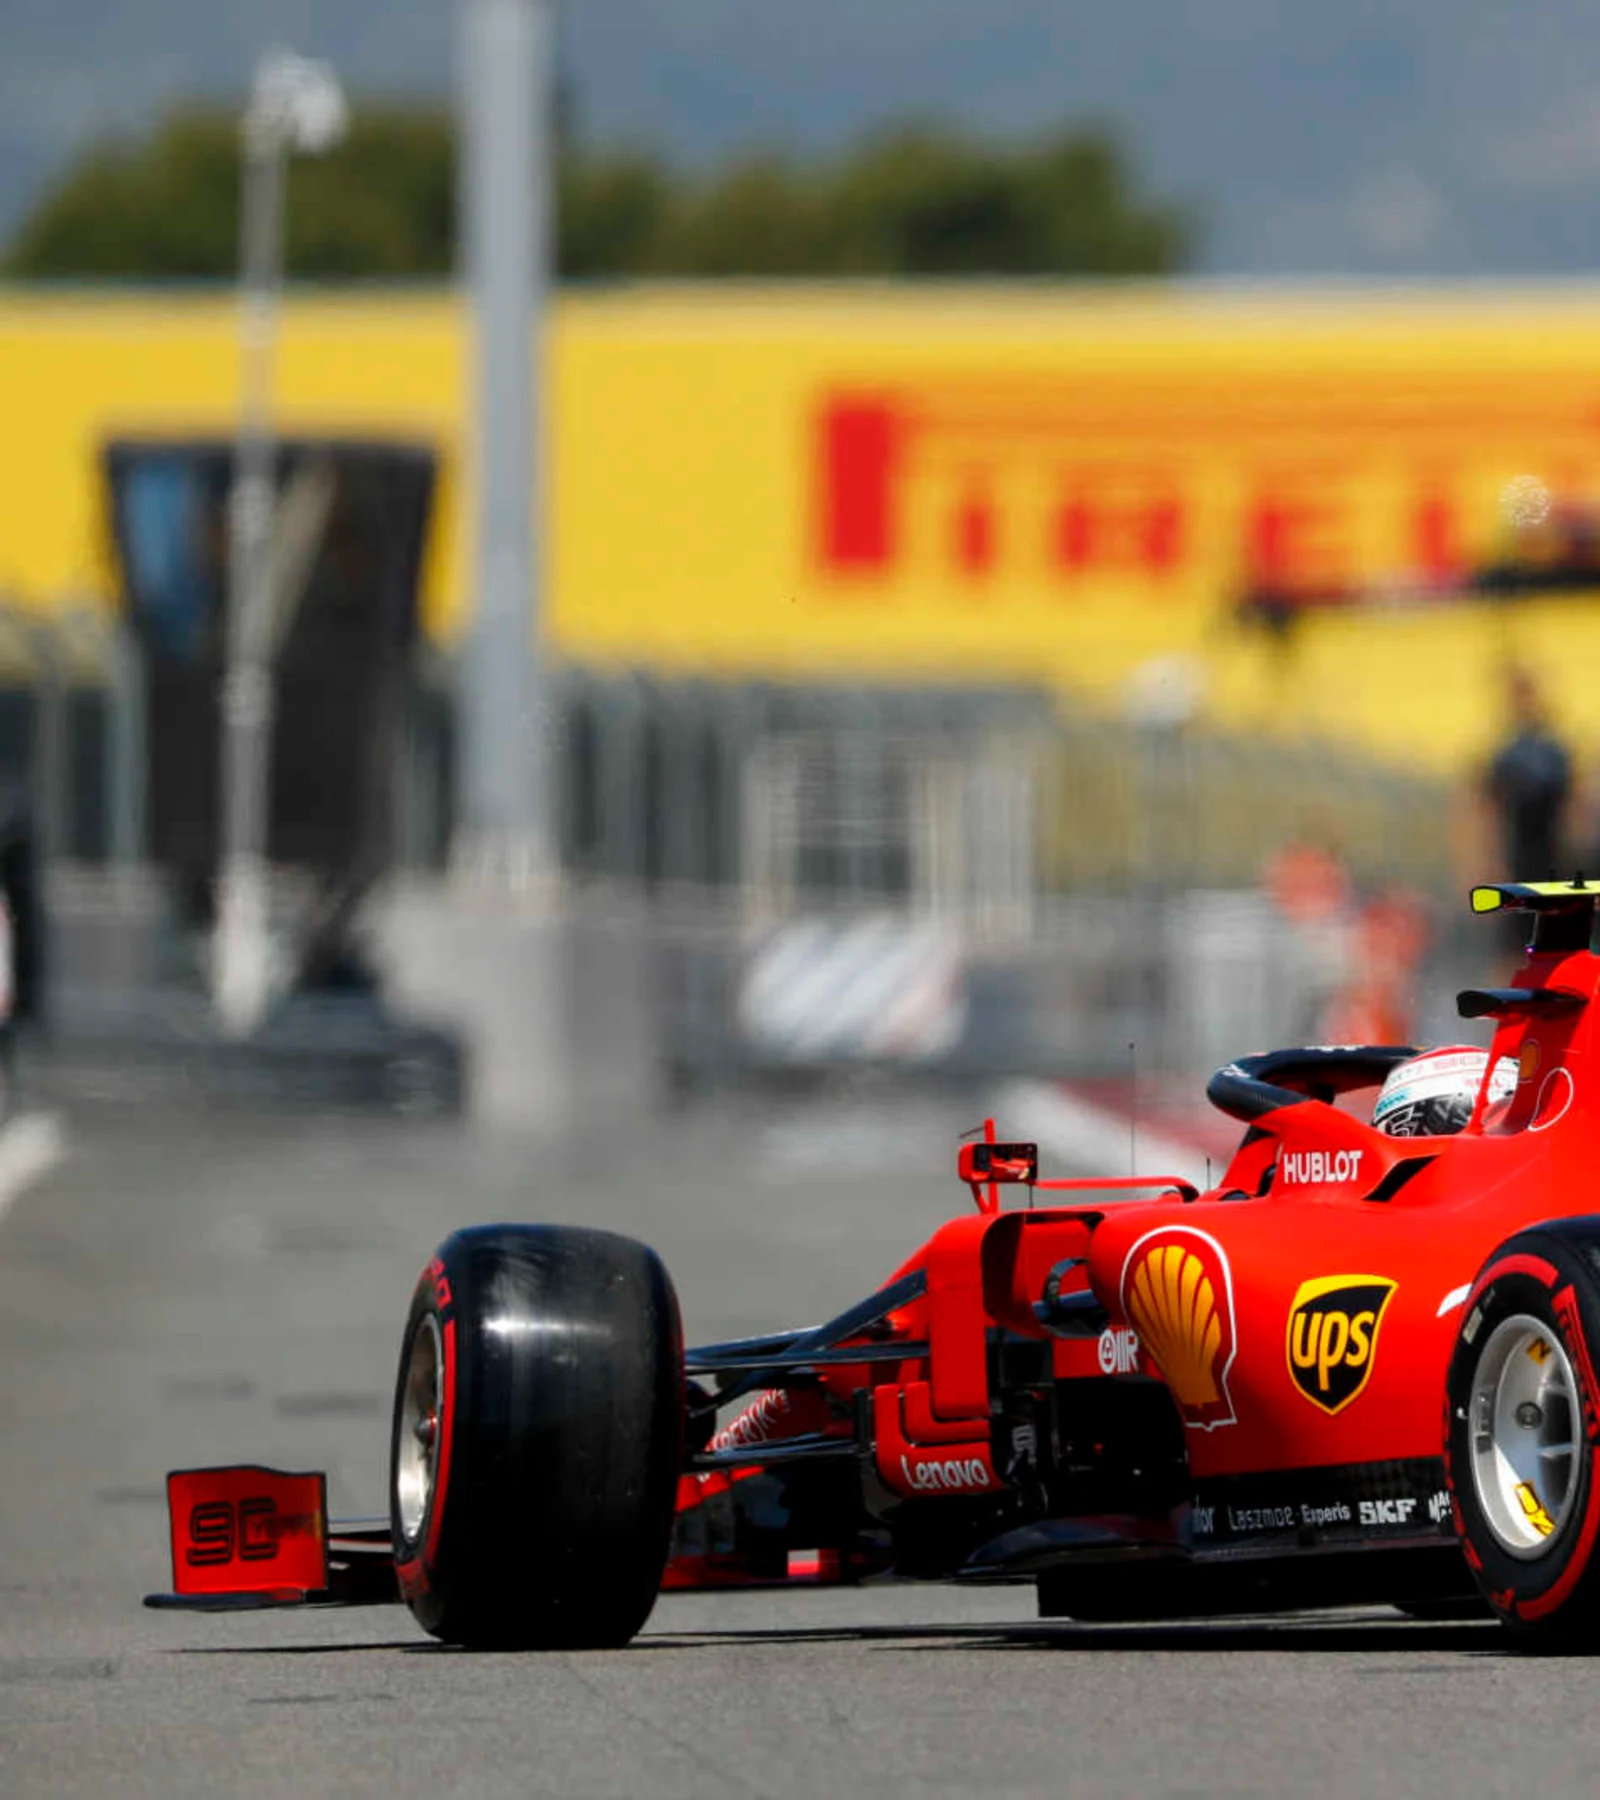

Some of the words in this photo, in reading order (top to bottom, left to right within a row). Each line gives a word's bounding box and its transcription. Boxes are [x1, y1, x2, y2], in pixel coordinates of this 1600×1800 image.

[1283, 1150, 1363, 1184] HUBLOT
[900, 1454, 989, 1489] Lenovo
[1358, 1498, 1417, 1525] SKF
